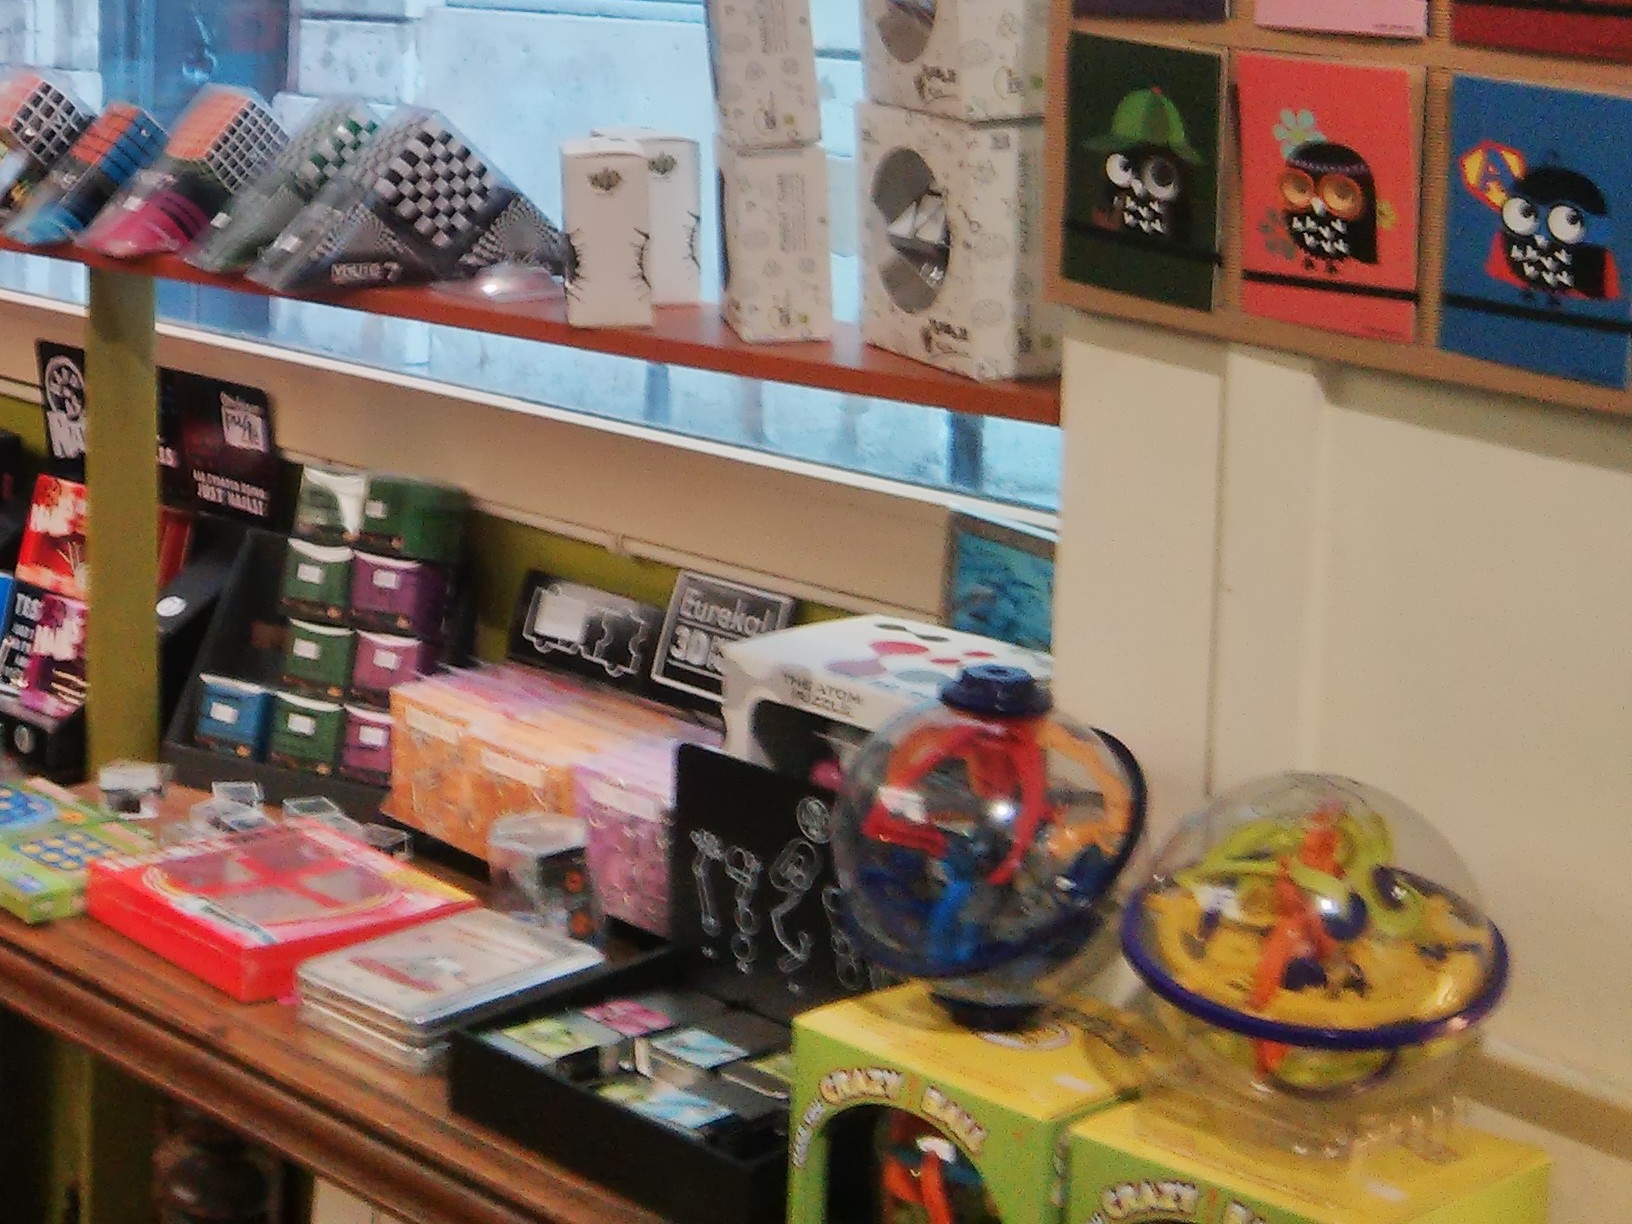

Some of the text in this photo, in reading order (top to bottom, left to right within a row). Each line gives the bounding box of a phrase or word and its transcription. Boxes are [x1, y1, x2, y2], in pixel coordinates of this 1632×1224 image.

[681, 586, 773, 636] Eureka!
[819, 1066, 904, 1104] CRAZY
[1099, 1178, 1200, 1221] CRAZY
